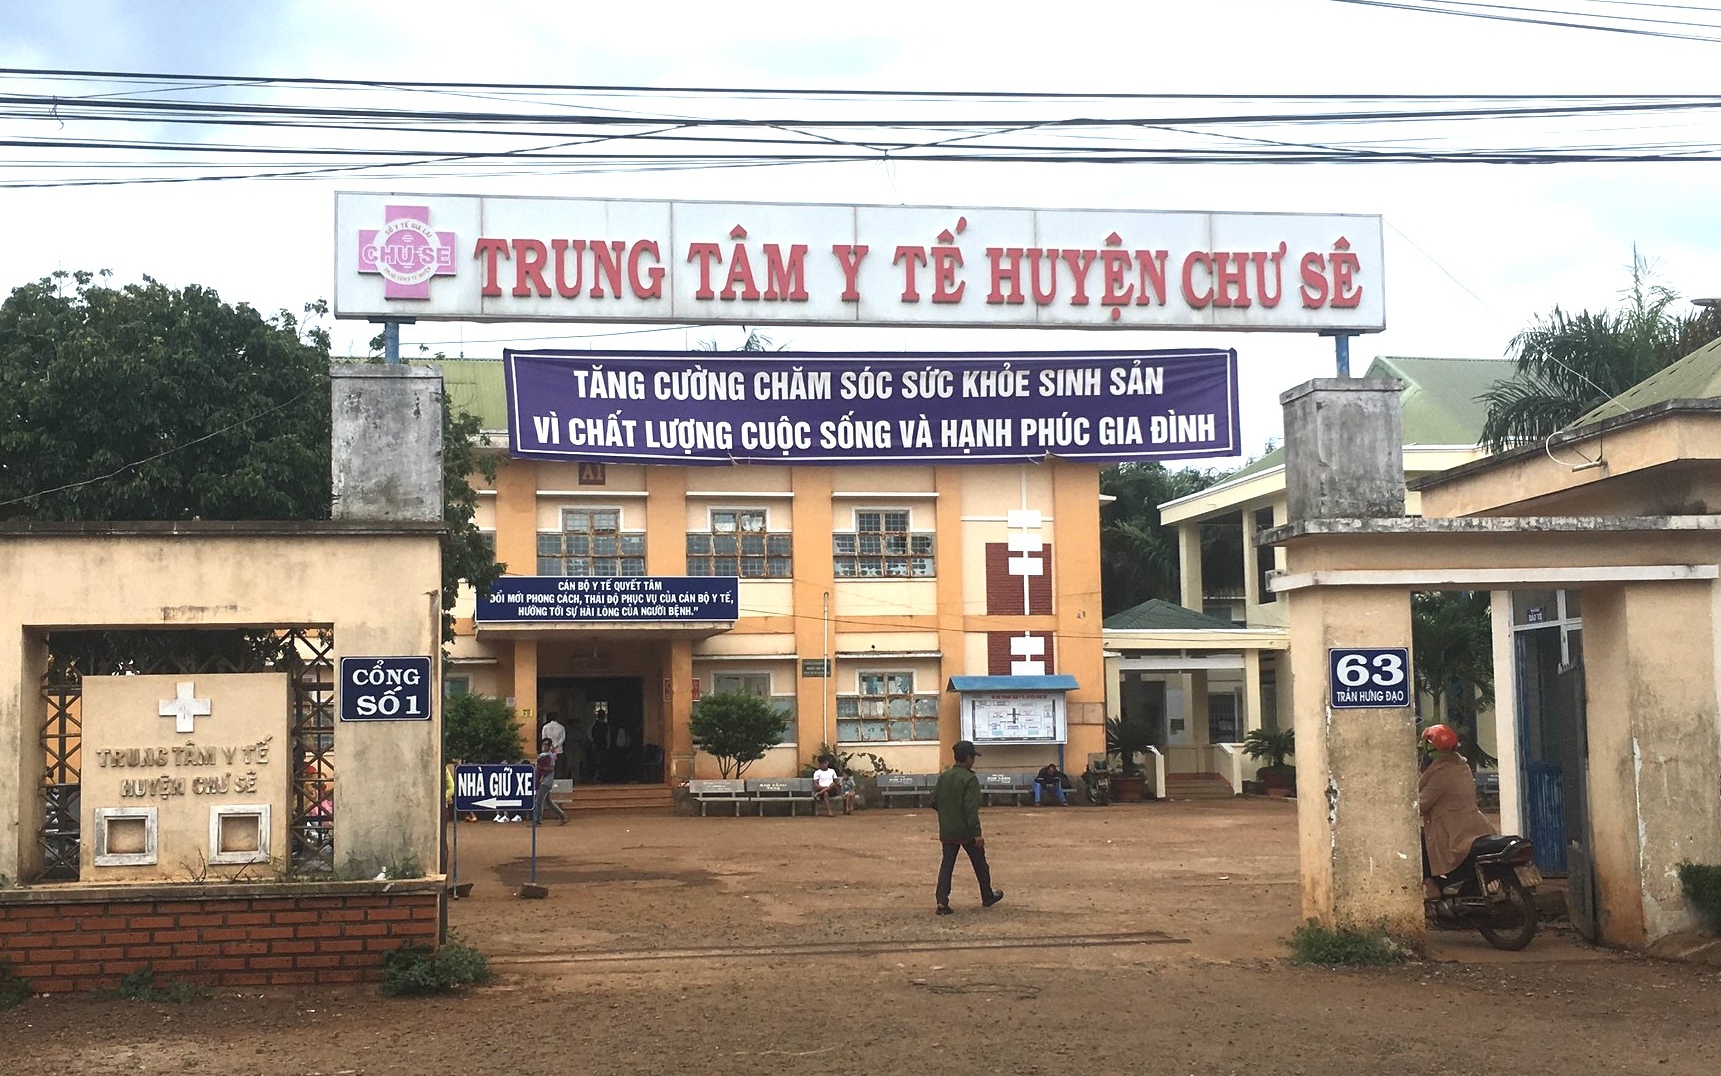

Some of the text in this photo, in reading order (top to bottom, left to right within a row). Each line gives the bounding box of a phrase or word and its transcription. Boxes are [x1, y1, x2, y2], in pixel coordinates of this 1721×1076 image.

[473, 216, 1364, 322] TRUNG TÂM Y TẾ HUYỆN CHƯ SÊ
[574, 359, 1165, 402] TĂNG CƯỜNG CHĂM SÓC SỨC KHỎE SINH SẢN
[533, 411, 1215, 456] VÌ CHẤT LƯỢNG CUỘC SỐNG VÀ HẠNH PHÚC GIA ĐÌNH
[508, 590, 525, 603] MỚI
[526, 593, 555, 603] PHONG
[557, 591, 582, 605] CÁCH,
[584, 591, 605, 604] THÁI
[607, 592, 619, 605] ĐỘ
[621, 593, 644, 605] PHỤC
[646, 593, 658, 605] VỤ
[660, 590, 677, 603] CỦA
[679, 591, 696, 603] CÁN
[698, 591, 710, 604] BỘ
[711, 593, 718, 603] Y
[720, 589, 734, 604] TẾ,
[558, 578, 662, 592] CÁN BỘ Y TẾ QUYẾT TÂM
[518, 604, 547, 616] HƯỚNG
[549, 604, 564, 616] TỚI
[566, 605, 578, 618] SỰ
[580, 604, 595, 617] HÀI
[597, 604, 620, 617] LÒNG
[622, 603, 639, 616] CỦA
[641, 604, 666, 616] NGƯỜI
[352, 659, 421, 685] CỔNG
[1336, 653, 1405, 687] 63
[356, 686, 421, 716] SỐ 1
[1337, 687, 1404, 703] TRẦN HƯNG ĐẠO
[96, 736, 274, 768] TRUNG TÂM Y TẾ
[121, 770, 258, 800] HUYỆN CHƯ SÊ
[458, 766, 485, 797] NHÀ
[489, 766, 513, 797] GIỮ
